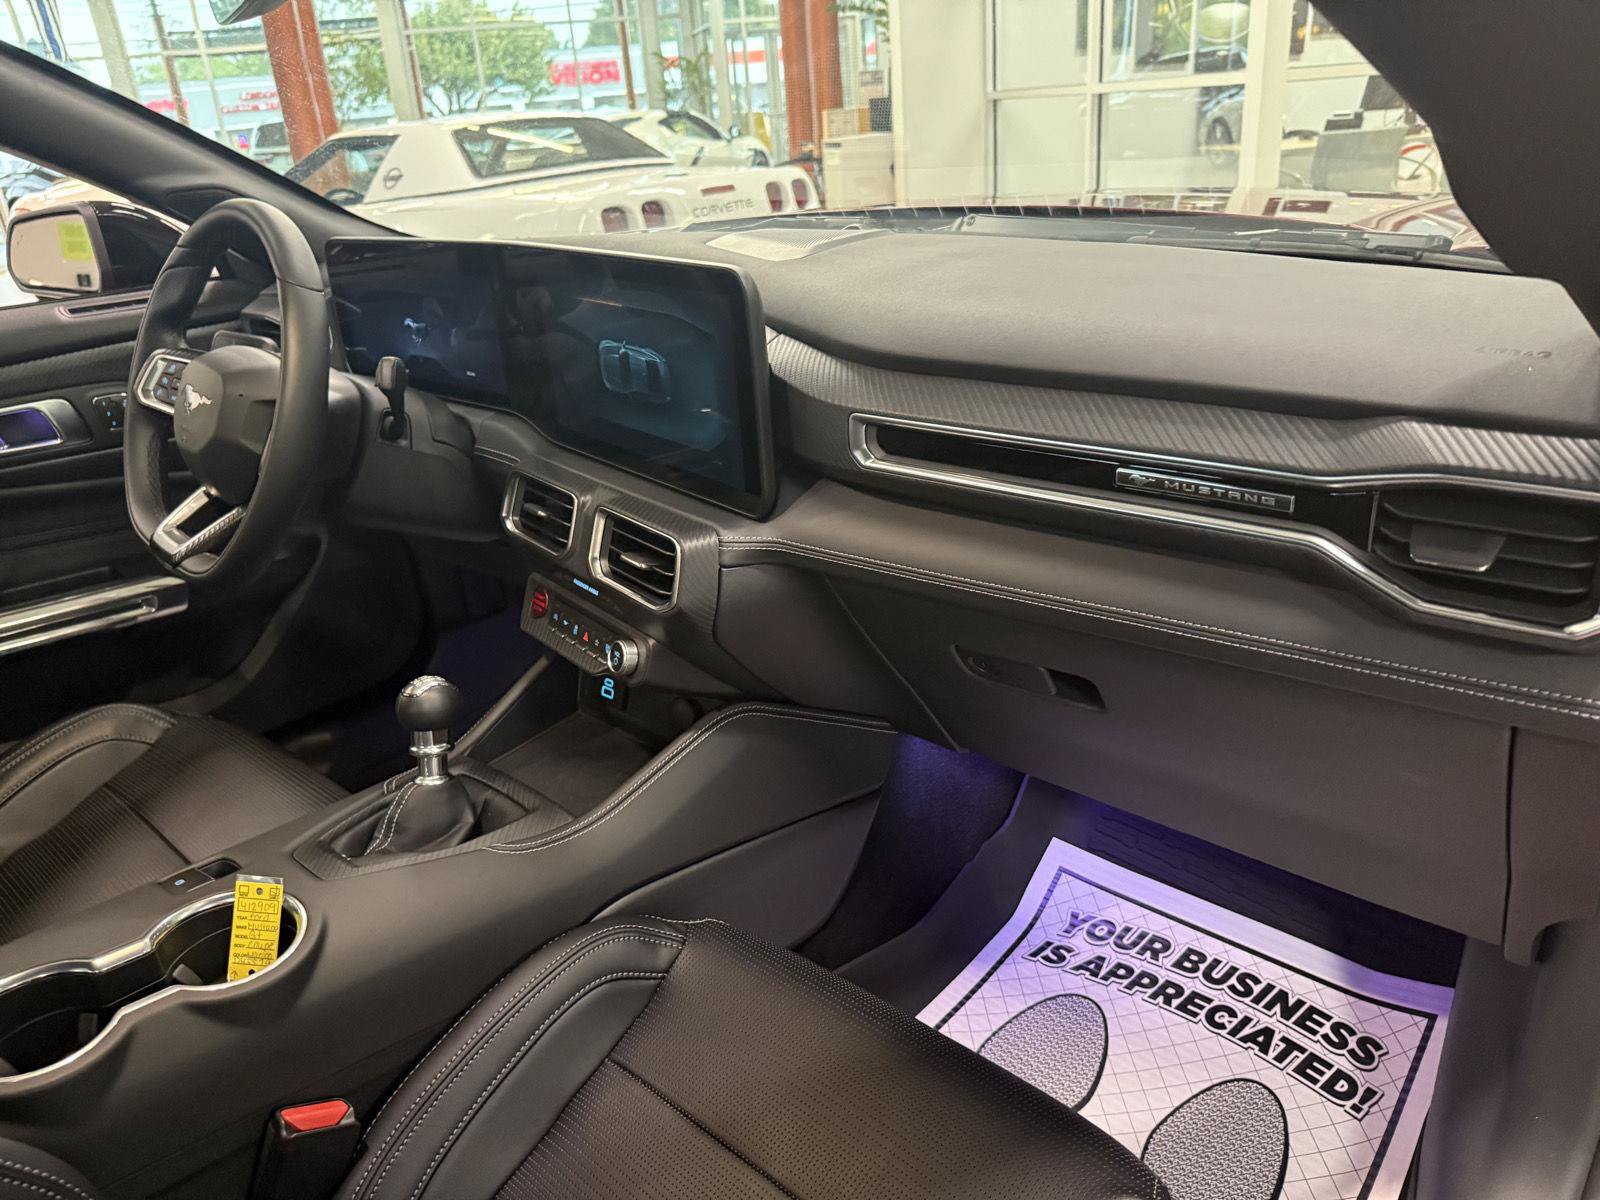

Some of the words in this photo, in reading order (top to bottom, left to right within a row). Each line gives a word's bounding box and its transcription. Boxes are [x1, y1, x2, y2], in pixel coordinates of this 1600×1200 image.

[692, 199, 753, 218] CORVETTE
[1164, 480, 1276, 506] MUSTANG
[1026, 939, 1078, 967] IS
[1070, 955, 1382, 1117] APPRECIATED!
[1060, 909, 1173, 964] YOUR
[1169, 946, 1389, 1069] BUSINESS
